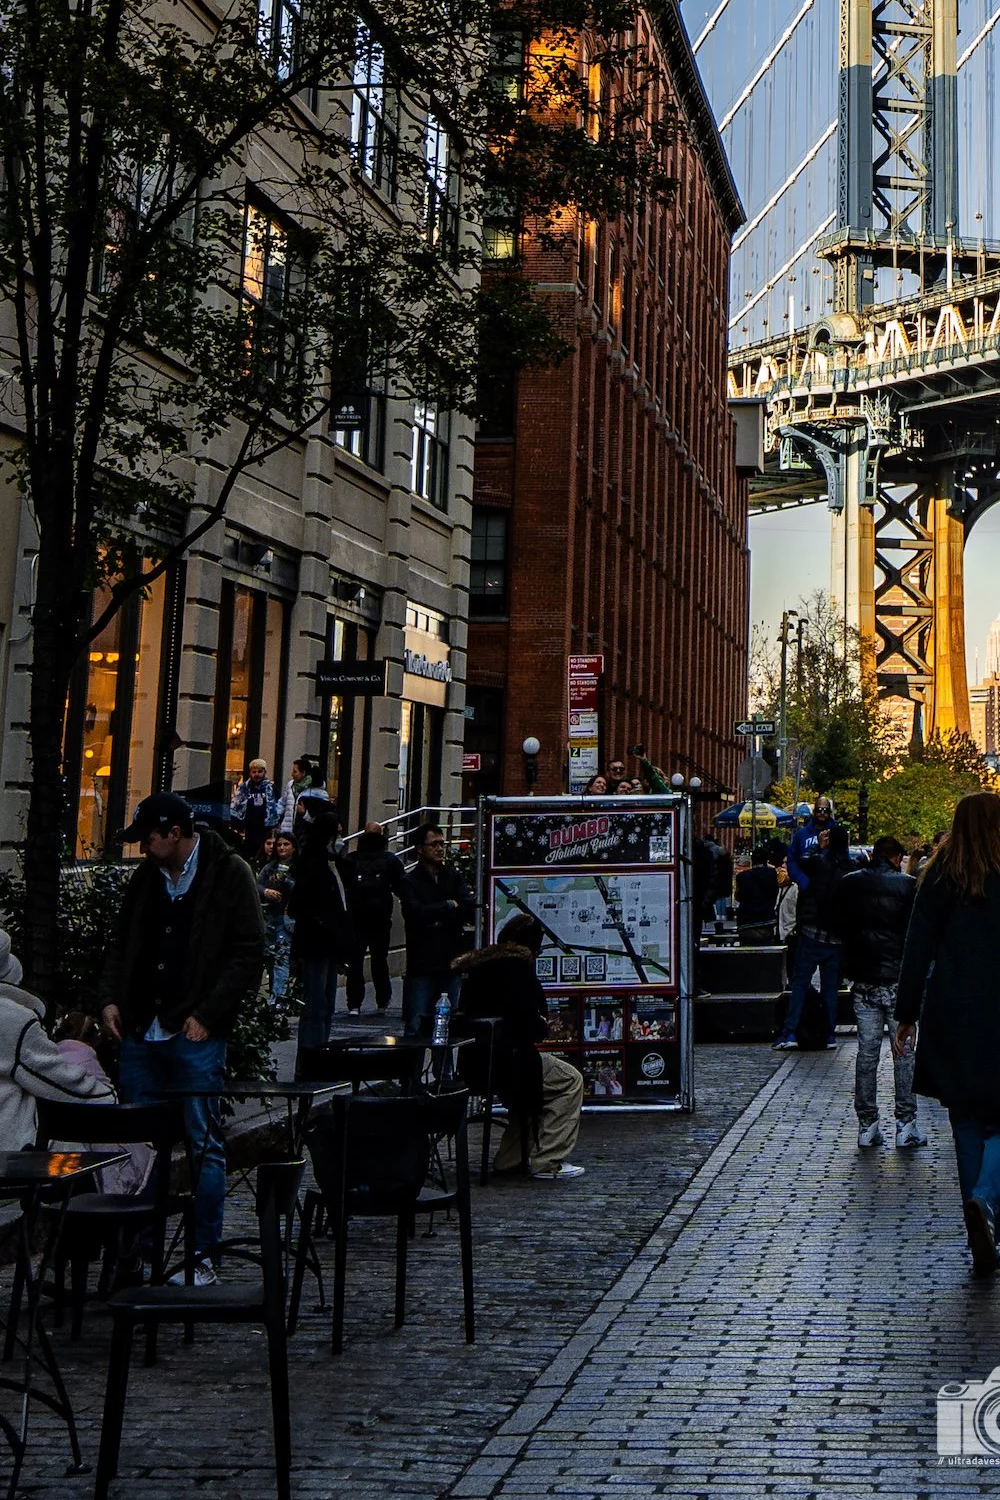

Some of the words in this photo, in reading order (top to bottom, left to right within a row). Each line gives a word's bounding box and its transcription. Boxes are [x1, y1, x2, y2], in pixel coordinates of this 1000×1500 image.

[571, 747, 579, 757] 2
[549, 817, 610, 850] DUMBO
[544, 843, 589, 864] Holiday
[589, 835, 620, 854] Guide
